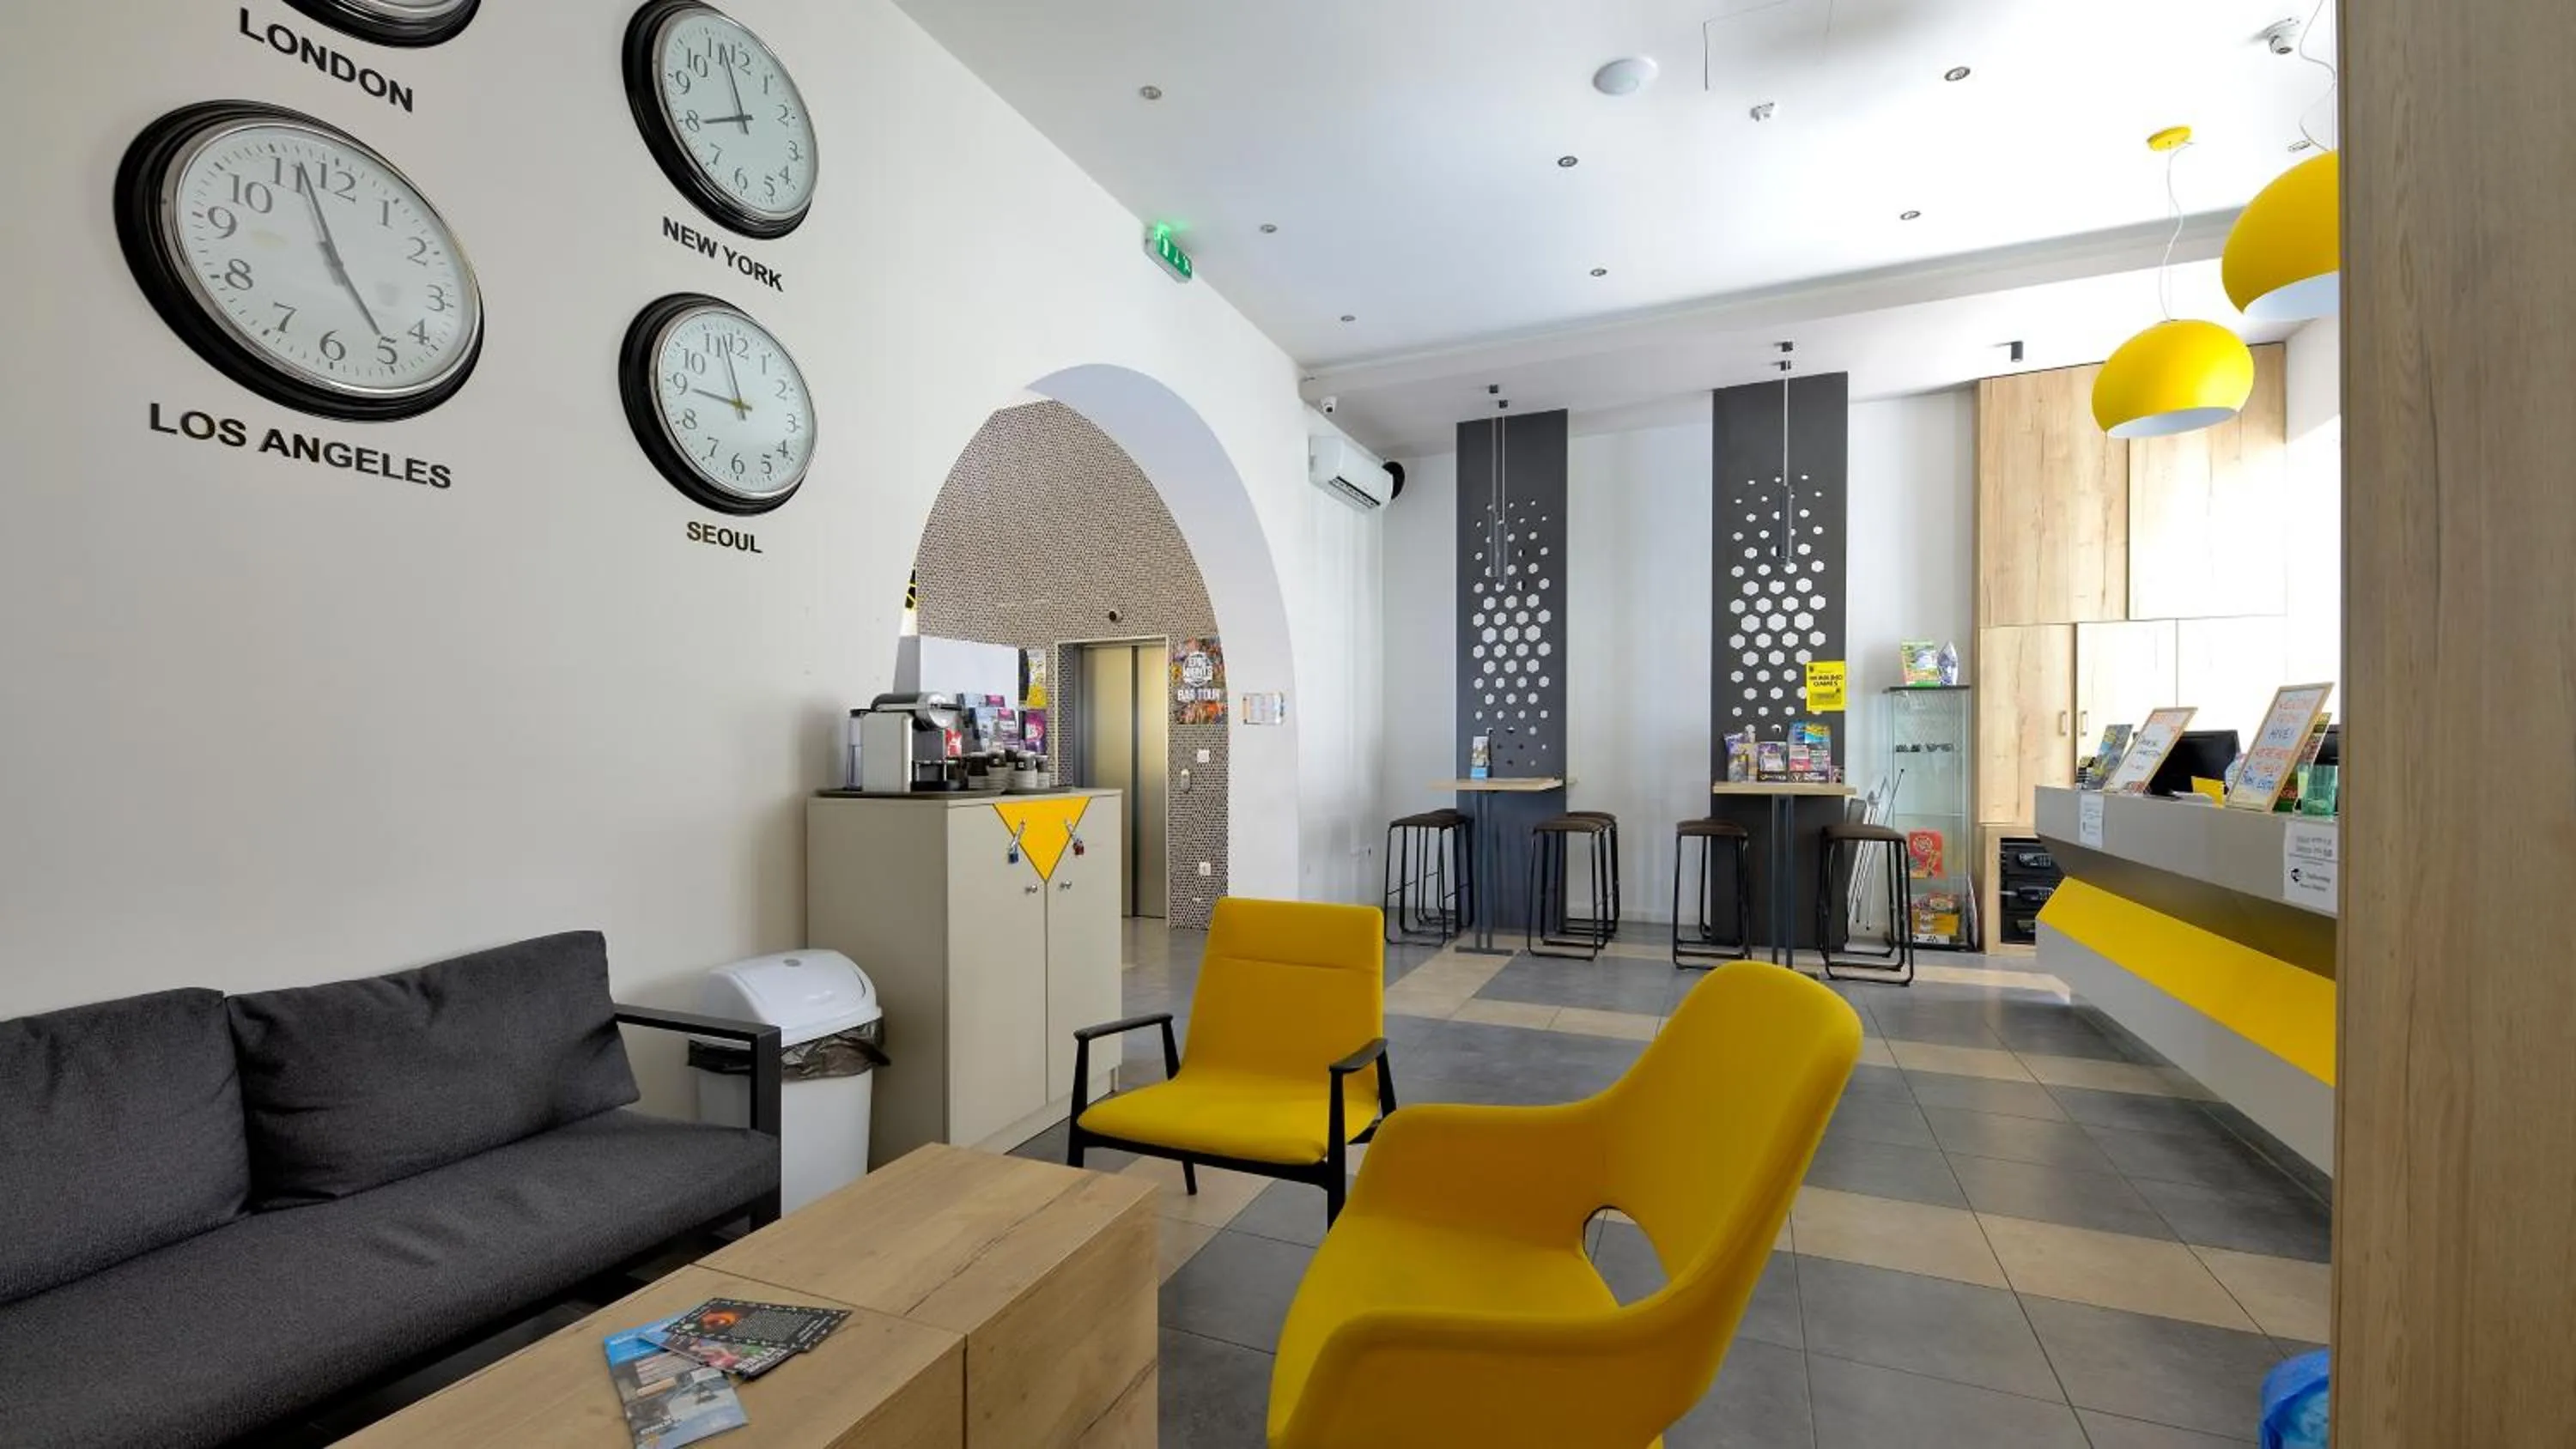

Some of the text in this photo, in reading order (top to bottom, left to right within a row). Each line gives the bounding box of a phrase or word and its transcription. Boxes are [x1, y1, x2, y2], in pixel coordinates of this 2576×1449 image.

[239, 7, 414, 113] LONDON
[687, 47, 708, 78] 10
[730, 44, 751, 76] 12
[674, 70, 691, 95] 9
[762, 75, 769, 95] 1
[684, 109, 702, 134] 8
[777, 104, 790, 127] 2
[709, 142, 723, 166] 7
[787, 140, 799, 161] 3
[270, 156, 304, 194] 11
[319, 162, 357, 203] 12
[734, 167, 748, 191] 6
[763, 175, 775, 197] 5
[779, 165, 790, 186] 4
[229, 174, 273, 214] 10
[208, 206, 238, 239] 9
[379, 200, 392, 228] 1
[407, 237, 429, 266] 2
[662, 215, 784, 293] NEW YORK
[225, 259, 254, 291] 8
[427, 284, 445, 312] 3
[273, 301, 297, 334] 7
[319, 330, 347, 361] 6
[408, 318, 429, 347] 4
[704, 333, 721, 358] 11
[378, 335, 398, 366] 5
[726, 333, 750, 360] 12
[682, 349, 706, 375] 10
[760, 354, 767, 375] 1
[672, 372, 688, 395] 9
[775, 379, 788, 400] 2
[682, 409, 698, 430] 8
[786, 413, 797, 433] 3
[149, 403, 453, 489] LOS ANGELES
[707, 436, 720, 458] 7
[776, 439, 788, 458] 4
[732, 453, 745, 476] 6
[760, 454, 772, 475] 5
[686, 521, 763, 554] SEOUL
